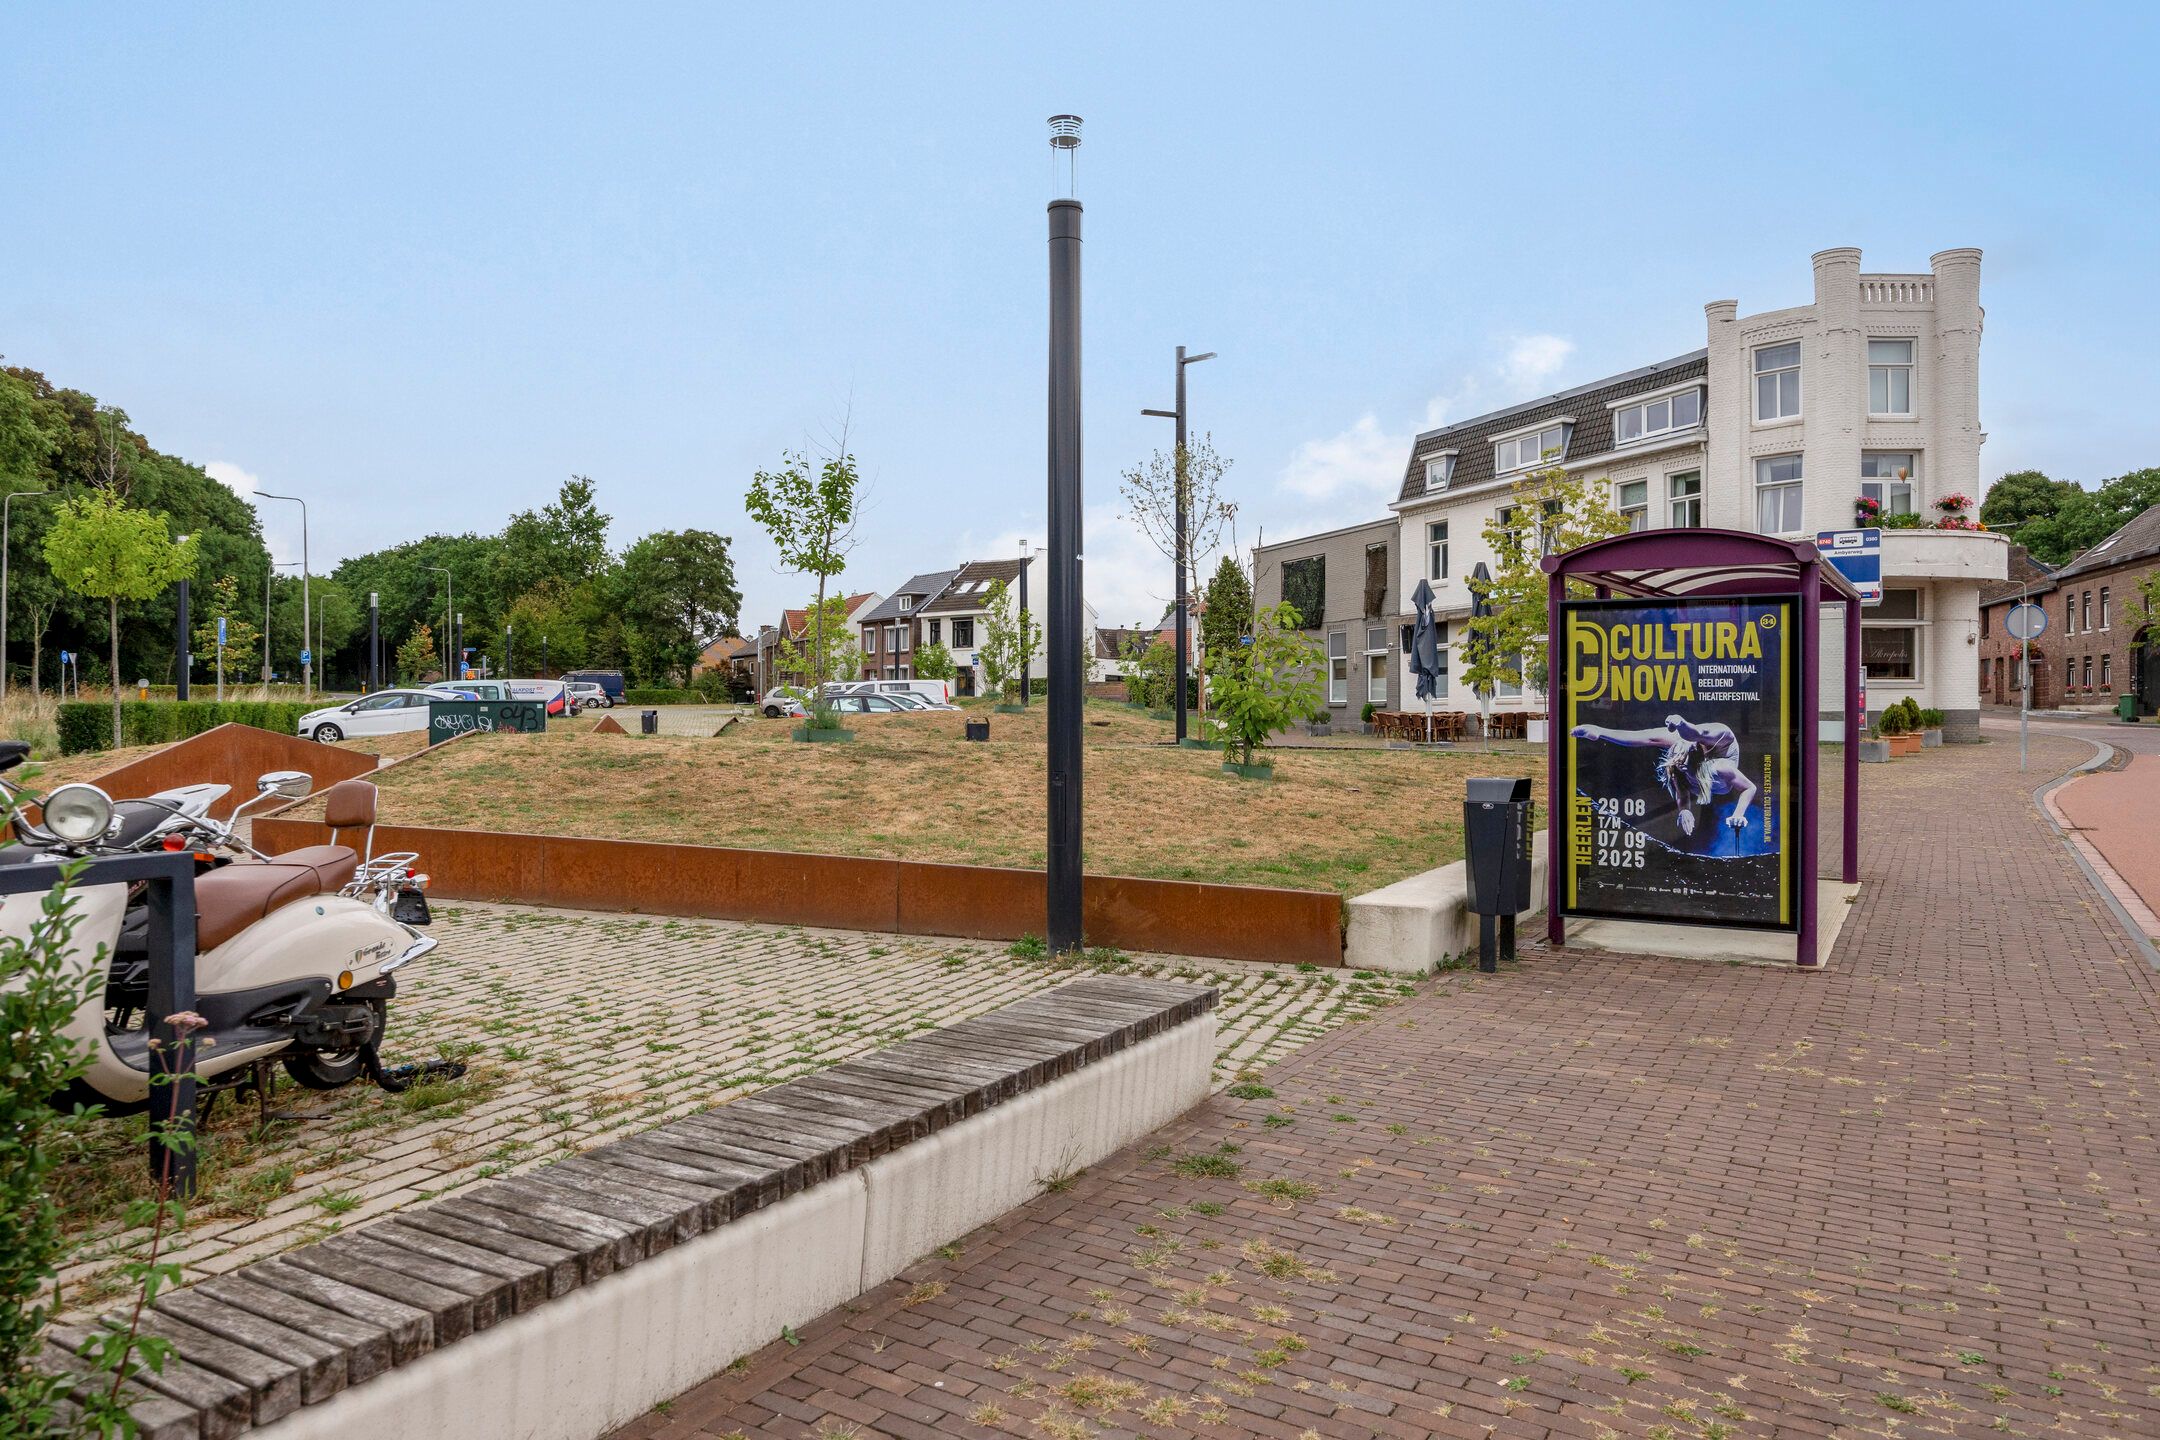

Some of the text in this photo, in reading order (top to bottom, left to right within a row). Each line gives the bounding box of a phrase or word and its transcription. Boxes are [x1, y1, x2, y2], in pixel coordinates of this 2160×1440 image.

[1610, 621, 1763, 661] CULTURA
[1698, 665, 1758, 675] INTERNATIONAAL
[1611, 665, 1695, 702] NOVA
[1698, 678, 1734, 688] BEELDEND
[1698, 691, 1761, 702] THEATERFESTIVAL
[1598, 797, 1646, 817] 29 08
[1576, 797, 1592, 865] HEERLEN
[1598, 816, 1621, 829] T/M
[1598, 829, 1646, 849] 07 09
[1598, 848, 1645, 868] 2025
